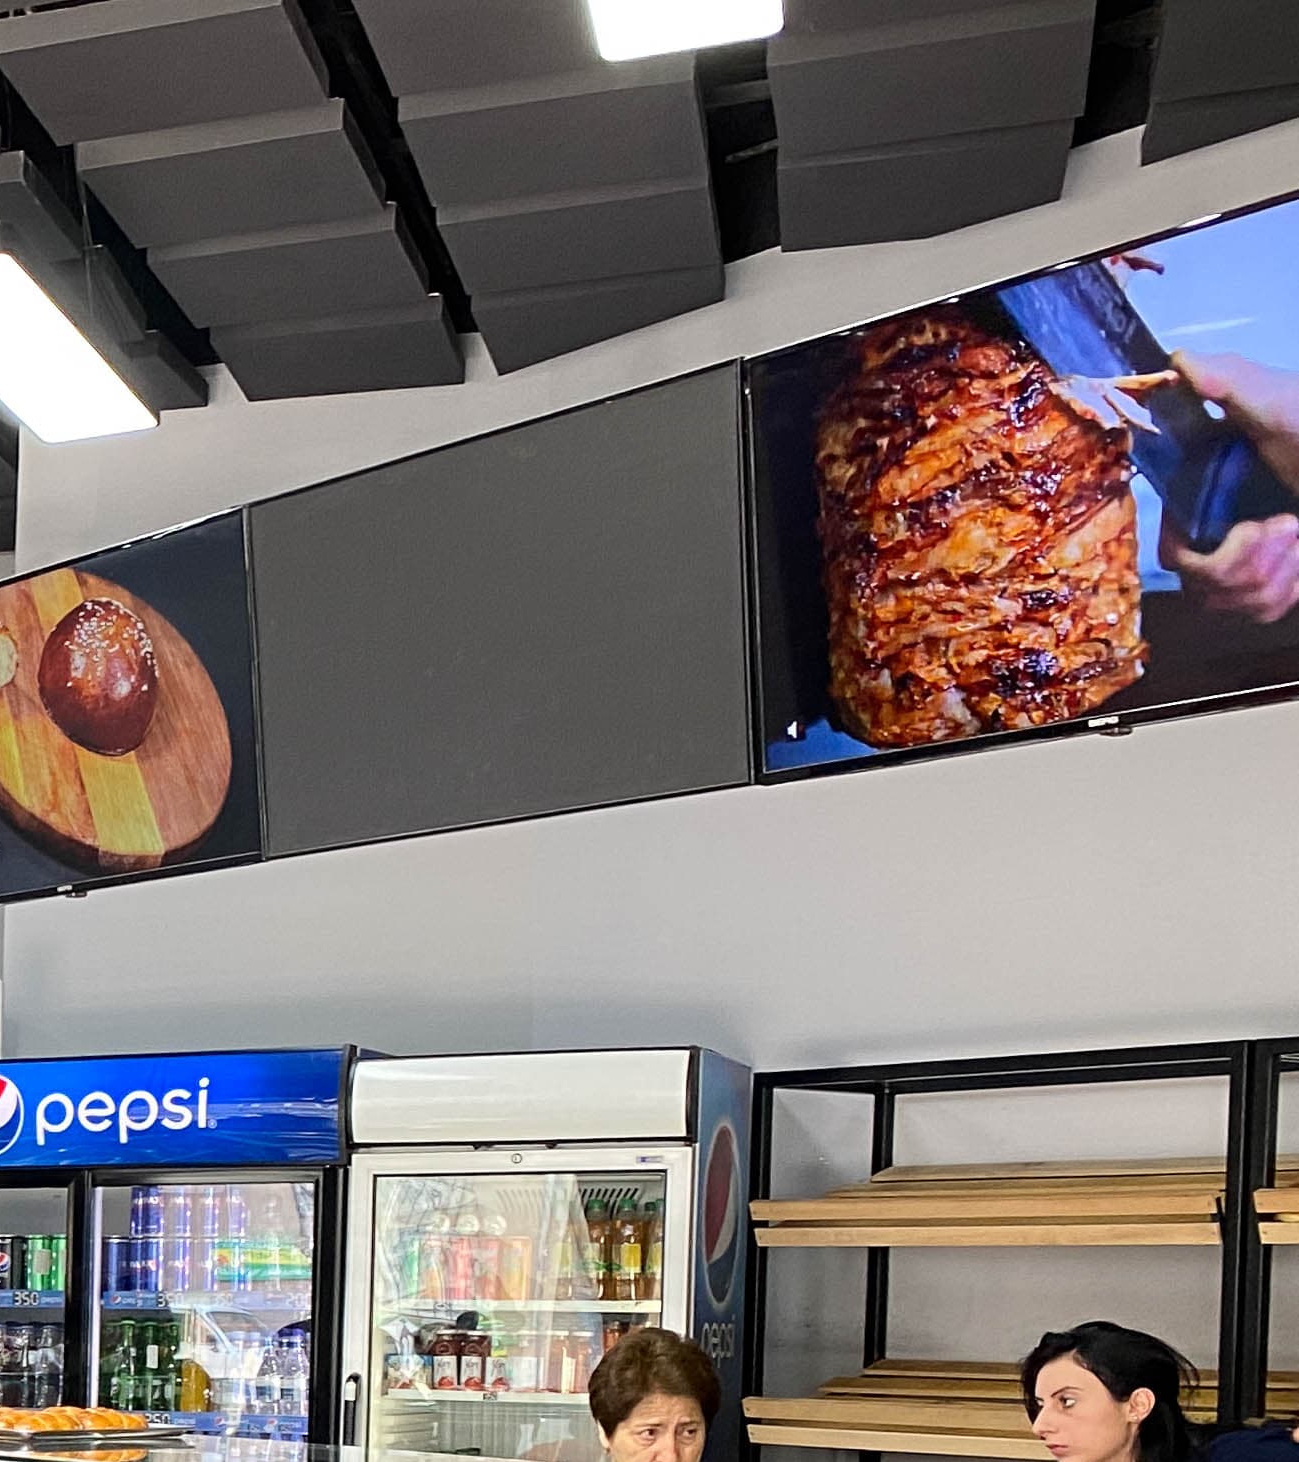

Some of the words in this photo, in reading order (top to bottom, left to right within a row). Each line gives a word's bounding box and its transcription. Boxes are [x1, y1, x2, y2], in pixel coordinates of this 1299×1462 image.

[36, 1077, 210, 1146] pepsi
[14, 1291, 39, 1305] 350
[701, 1313, 736, 1369] pepsi
